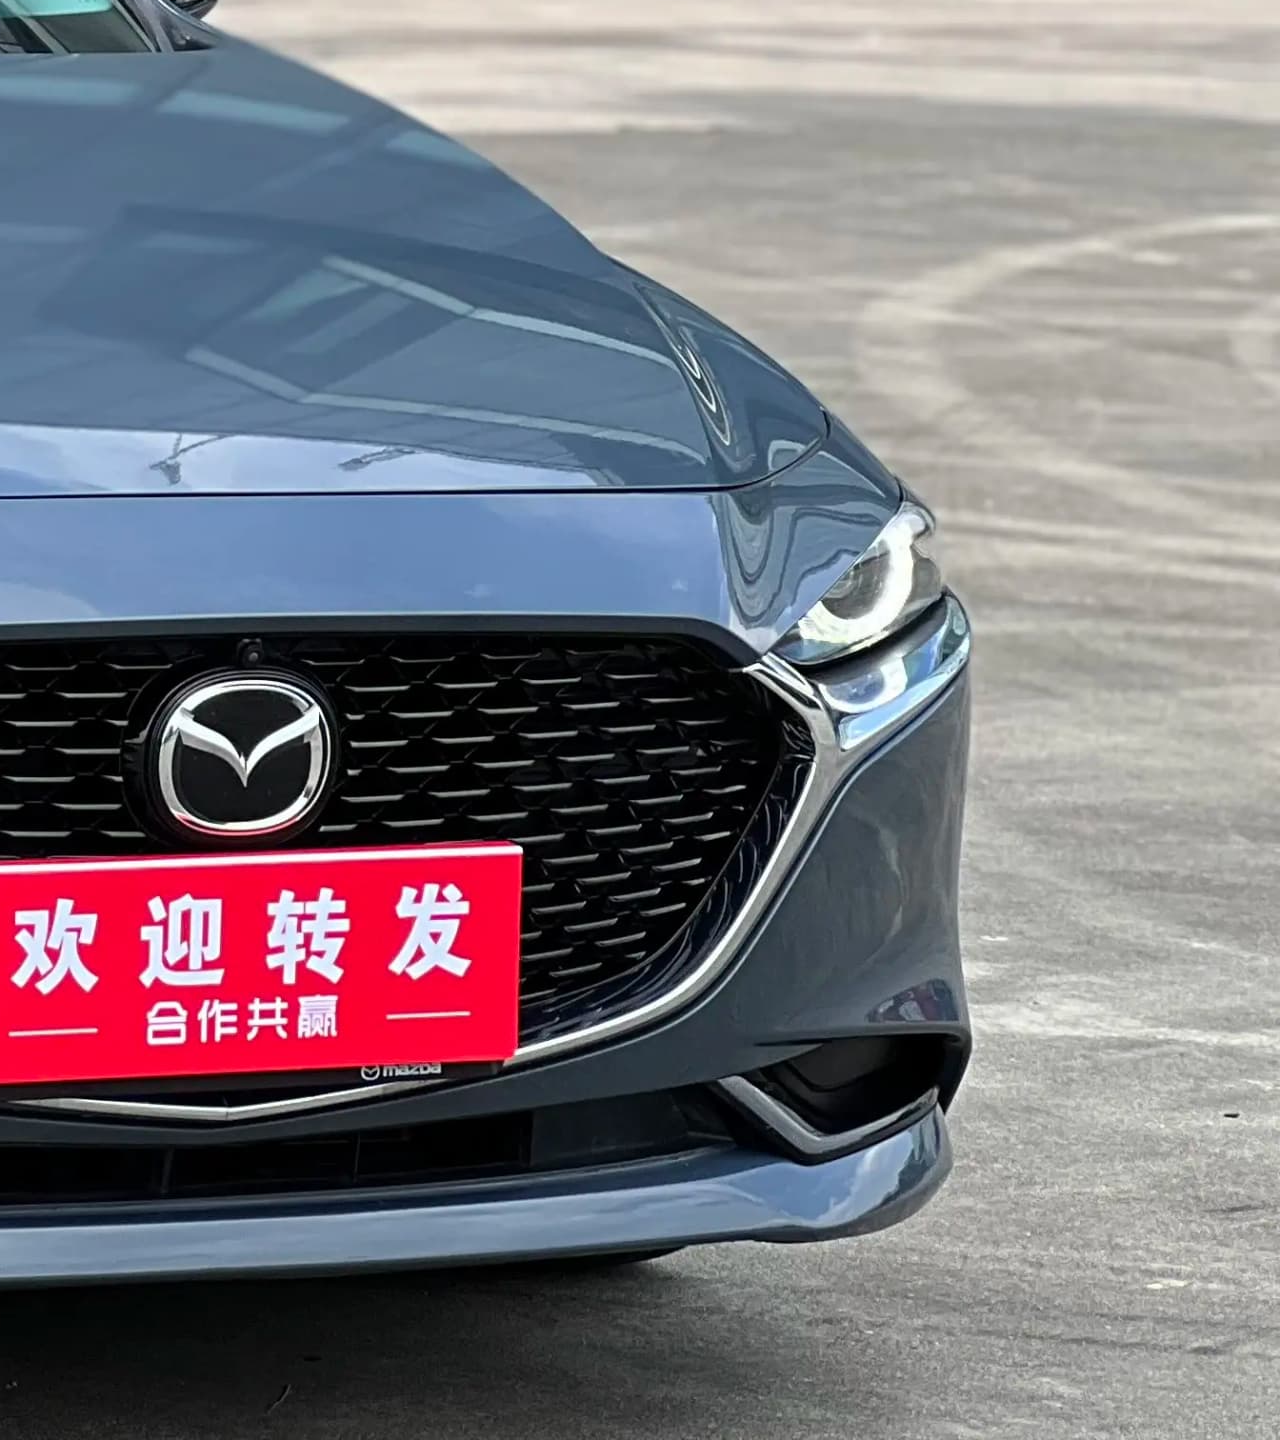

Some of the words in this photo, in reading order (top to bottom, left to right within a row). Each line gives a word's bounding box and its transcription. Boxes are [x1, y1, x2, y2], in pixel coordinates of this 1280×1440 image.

[10, 882, 473, 995] 欢迎转发
[146, 994, 339, 1046] 合作共赢
